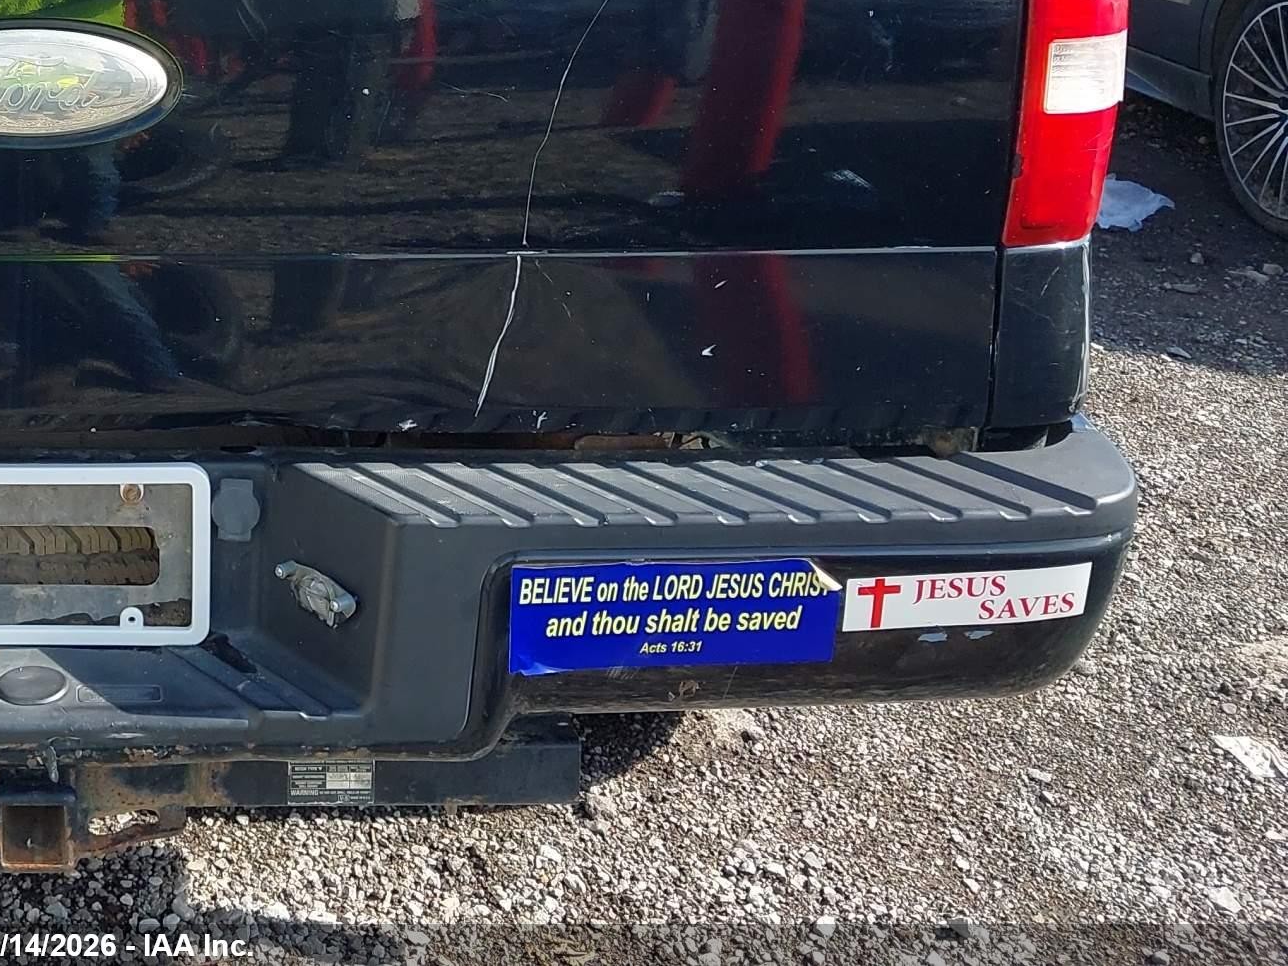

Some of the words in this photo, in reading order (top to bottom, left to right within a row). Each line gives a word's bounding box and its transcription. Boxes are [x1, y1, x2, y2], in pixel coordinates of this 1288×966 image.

[519, 577, 594, 604] BELIEVE
[597, 582, 620, 602] on
[623, 577, 649, 601] the
[652, 575, 703, 601] LORD
[706, 573, 764, 599] JESUS
[912, 575, 1006, 605] JESUS
[545, 612, 587, 637] and
[592, 610, 640, 635] thou
[645, 608, 700, 634] shalt
[703, 608, 731, 633] be
[736, 605, 803, 631] saved
[978, 592, 1075, 620] SAVES
[640, 642, 667, 654] Acts
[671, 641, 702, 653] 16:31
